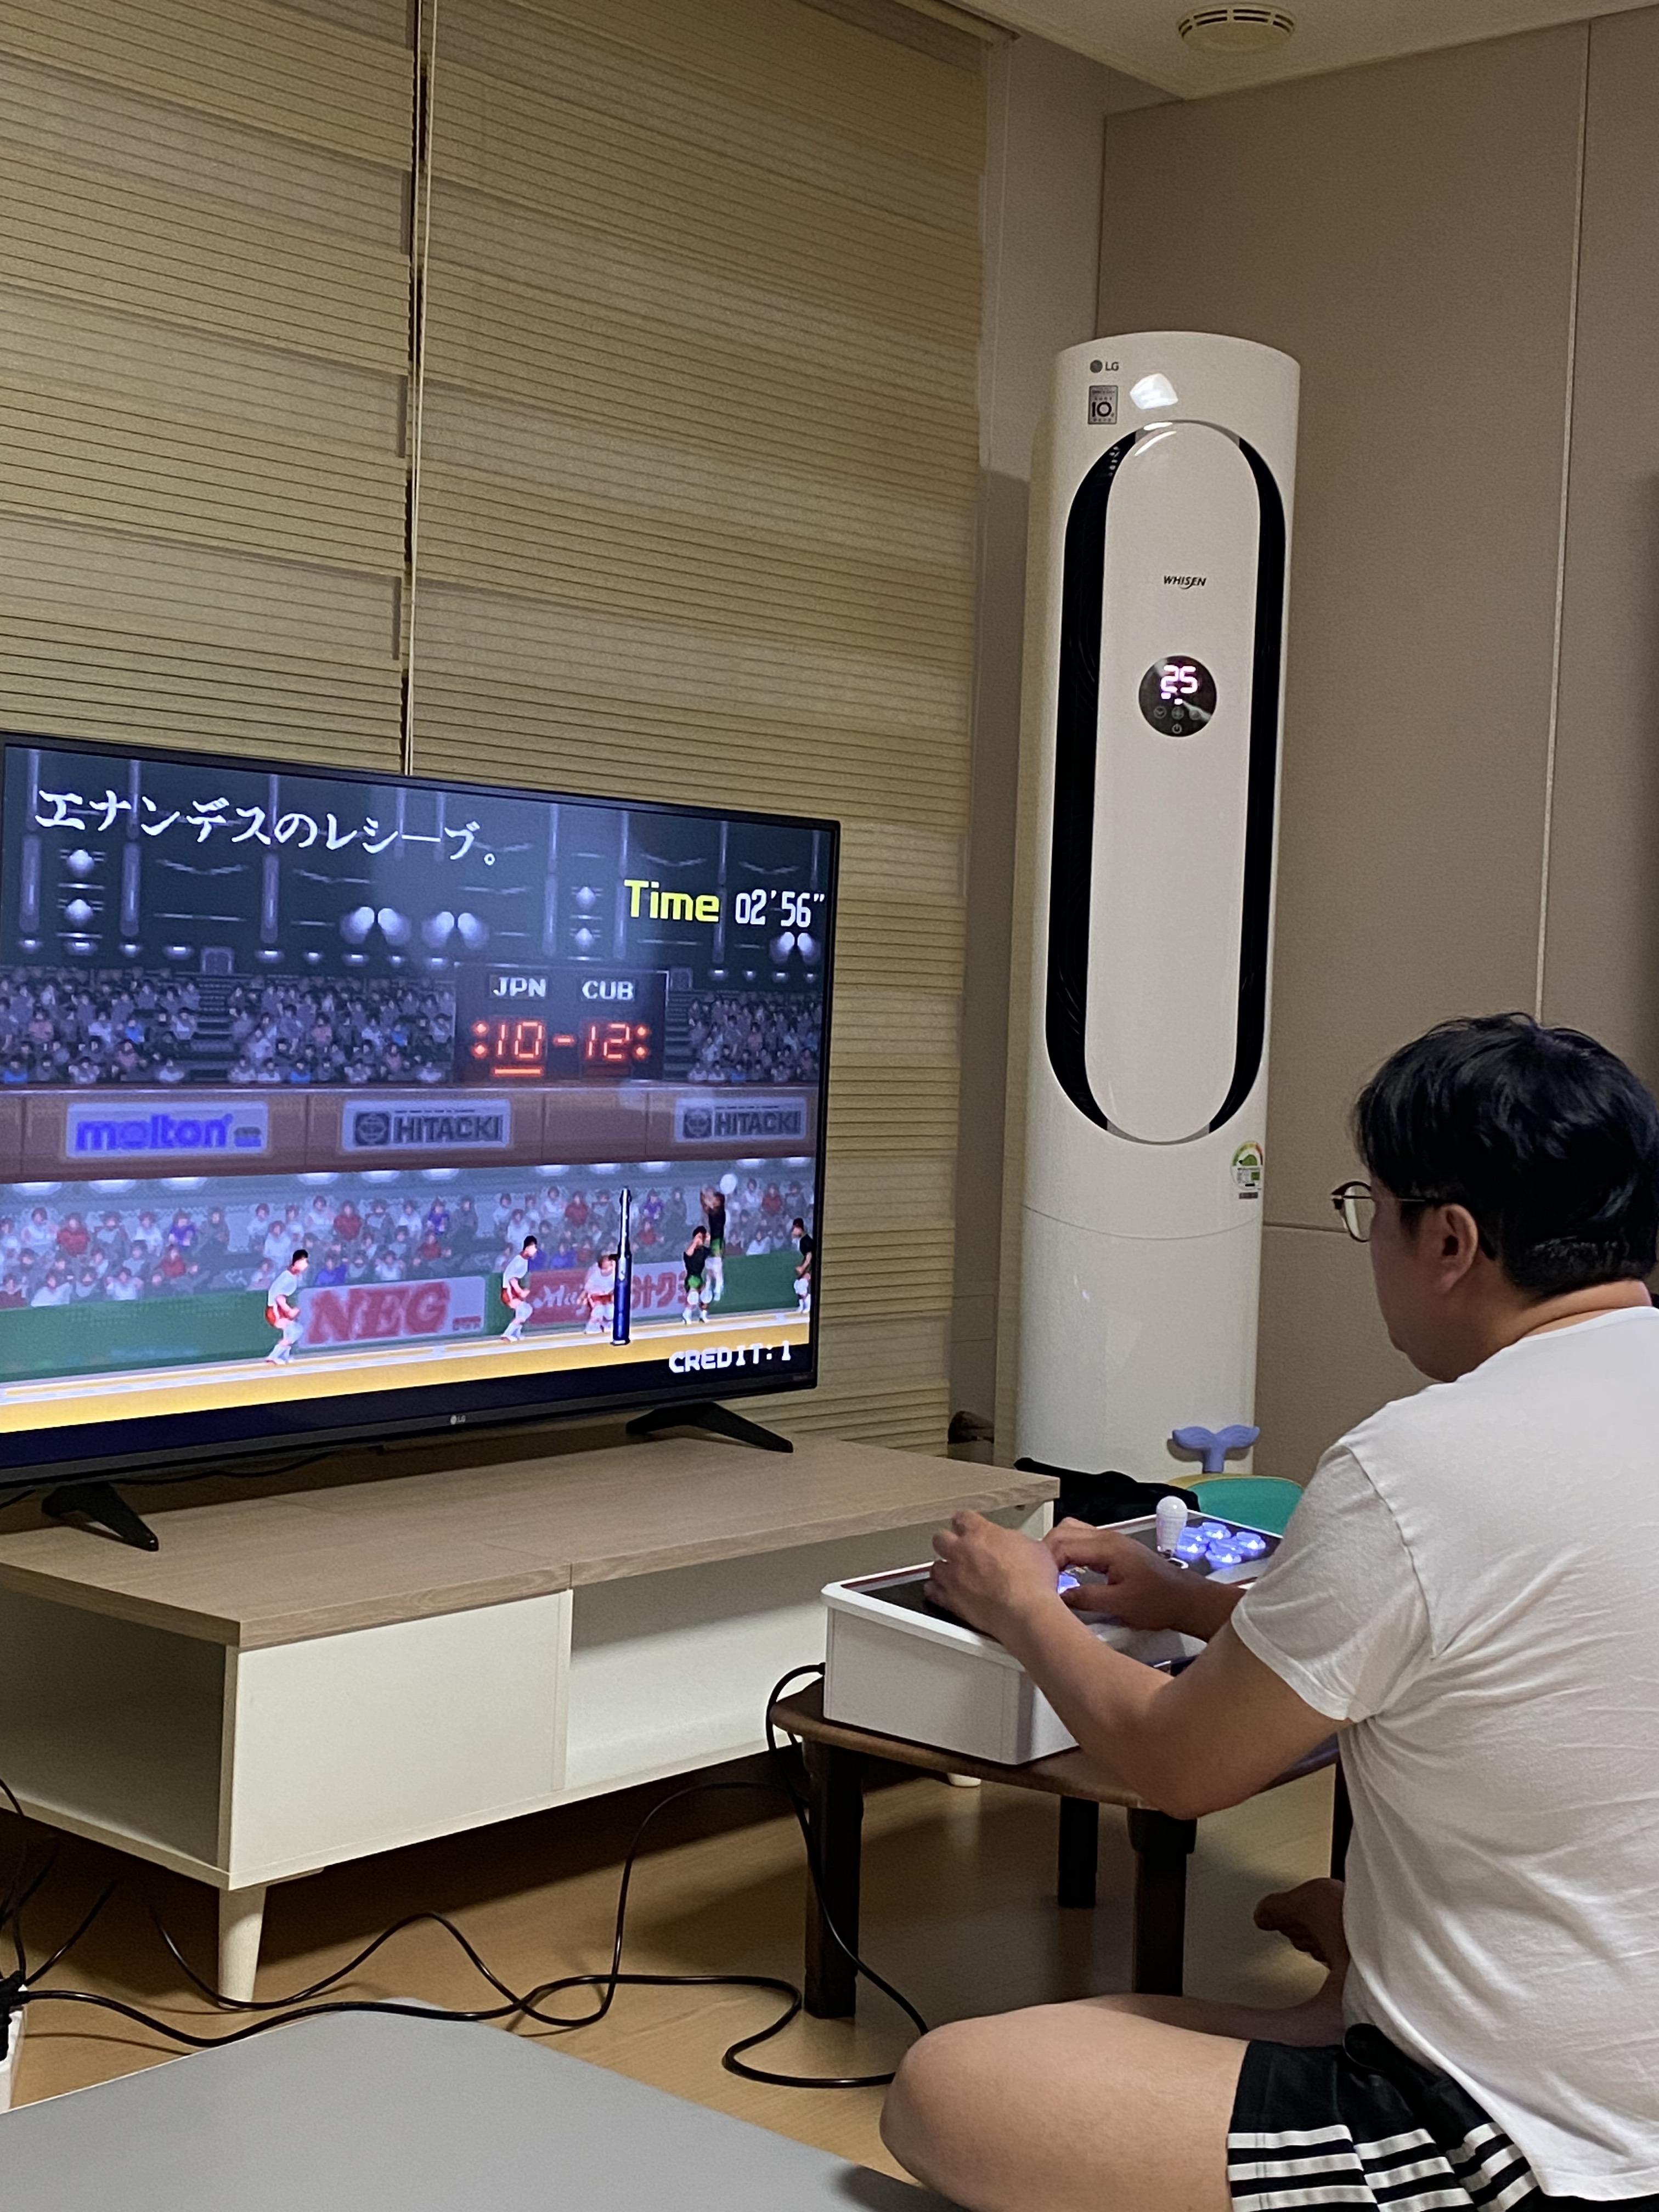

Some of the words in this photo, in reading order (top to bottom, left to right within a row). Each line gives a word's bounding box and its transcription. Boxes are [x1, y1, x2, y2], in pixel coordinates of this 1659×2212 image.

[1105, 361, 1119, 371] LG
[1164, 575, 1206, 589] WHISEN
[1160, 664, 1198, 693] 25
[624, 879, 719, 922] Time
[494, 977, 546, 997] JPN
[582, 980, 634, 1001] CUB
